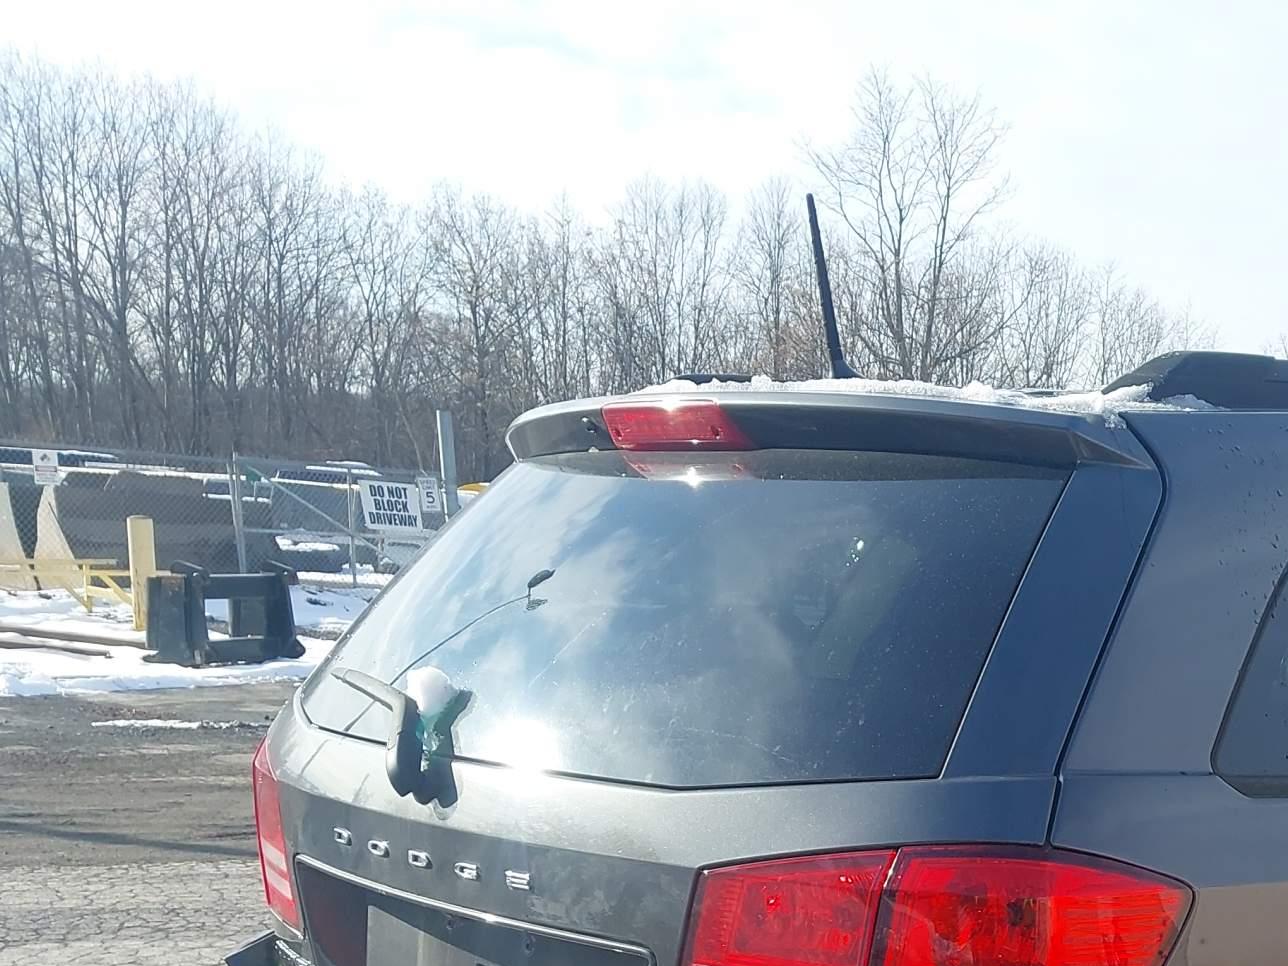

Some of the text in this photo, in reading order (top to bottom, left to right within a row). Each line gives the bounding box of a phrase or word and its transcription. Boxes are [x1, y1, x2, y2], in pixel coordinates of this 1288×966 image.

[369, 484, 408, 500] DO NOT
[425, 491, 436, 504] 5
[373, 498, 410, 513] BLOCK
[368, 512, 418, 528] DRIVEWAY
[333, 826, 533, 891] DODGE
